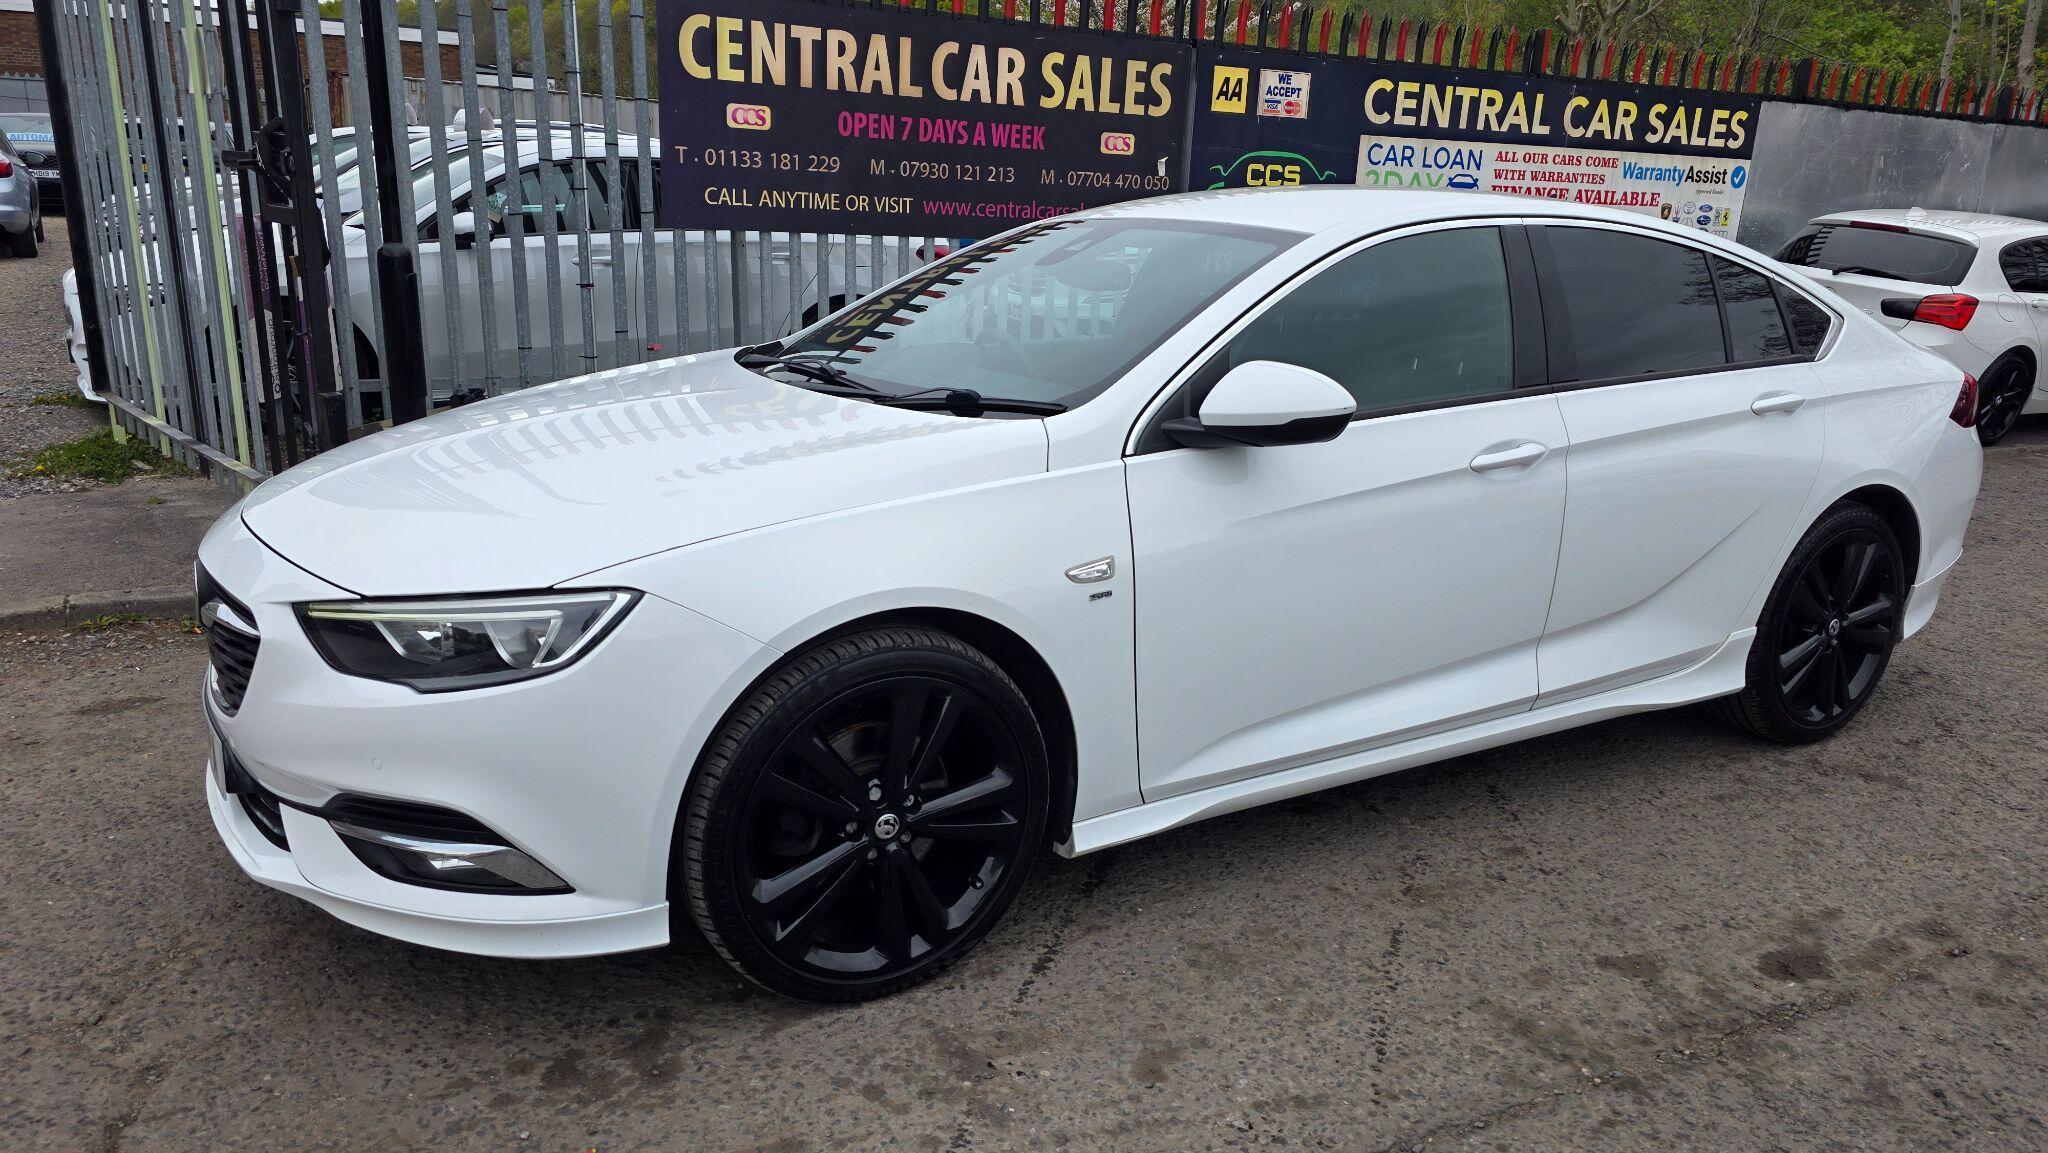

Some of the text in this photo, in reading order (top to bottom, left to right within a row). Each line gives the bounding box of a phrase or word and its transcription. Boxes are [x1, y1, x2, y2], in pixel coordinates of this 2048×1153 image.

[679, 14, 1173, 117] CENTRAL CAR SALES
[1216, 76, 1243, 102] AA
[1278, 73, 1292, 85] WE
[1266, 85, 1302, 98] ACCEPT
[731, 107, 767, 127] CCS
[1364, 78, 1749, 150] CENTRAL CAR SALES
[838, 111, 1047, 150] OPEN 7 DAYS A WEEK
[1104, 136, 1131, 152] CCS
[704, 148, 762, 168] 01133
[770, 152, 800, 171] 181
[807, 155, 841, 173] 229
[1367, 143, 1483, 171] CAR LOAN
[1495, 151, 1619, 169] ALL OUR CARS COME
[900, 161, 949, 179] 07930
[955, 164, 980, 181] 121
[987, 166, 1015, 183] 213
[1068, 171, 1111, 189] 07704
[1114, 173, 1140, 190] 470
[1144, 175, 1170, 191] 050
[1246, 163, 1301, 186] CCS
[1493, 169, 1606, 185] WITH WARRANTIES
[1622, 161, 1728, 187] WarrantyAssist
[704, 187, 753, 206] CALL
[759, 190, 840, 211] ANYTIME
[845, 194, 870, 212] OR
[874, 196, 914, 213] VISIT
[1574, 188, 1661, 207] AVAILABLE
